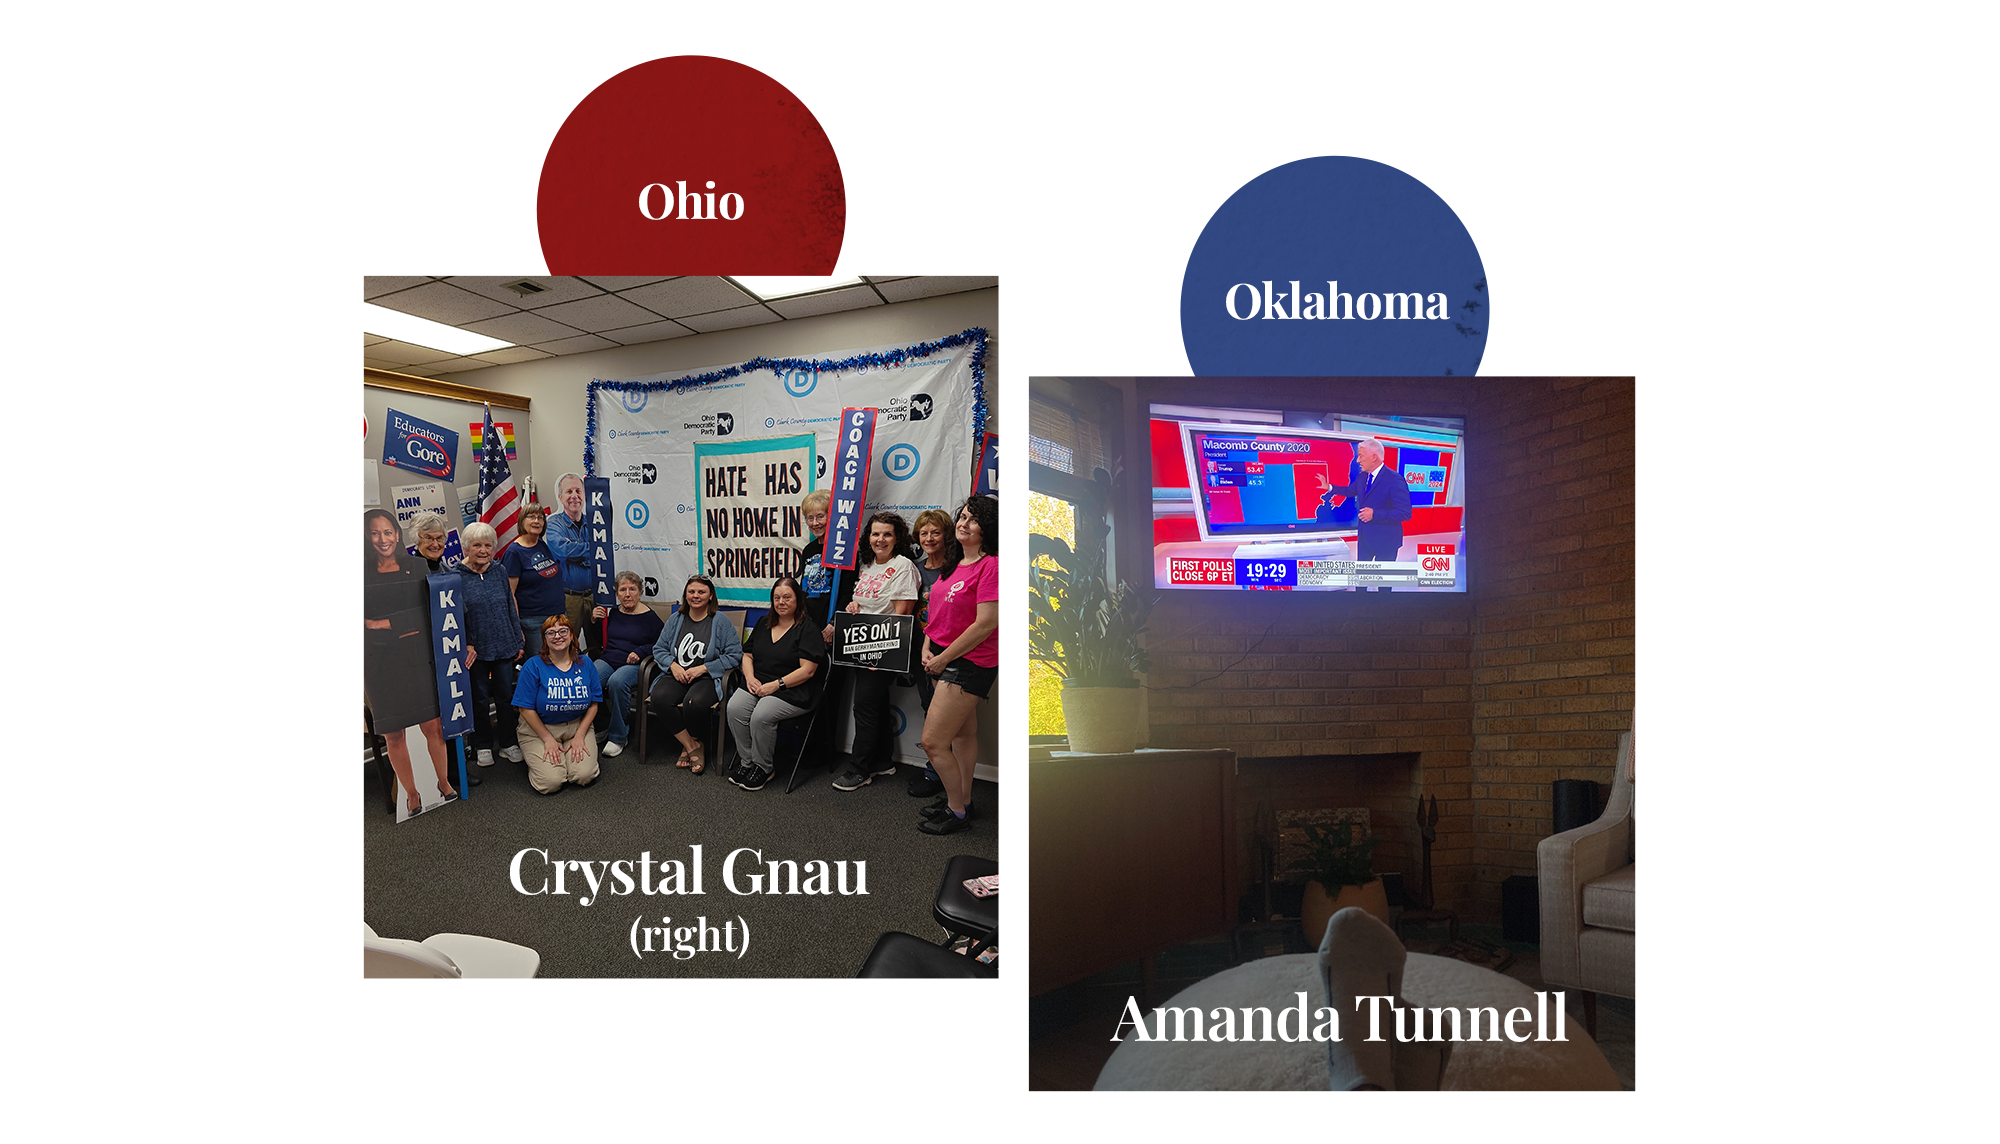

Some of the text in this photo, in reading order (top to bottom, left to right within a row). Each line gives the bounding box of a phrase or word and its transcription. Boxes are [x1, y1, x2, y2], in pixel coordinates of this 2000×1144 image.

[878, 405, 907, 414] mocratic
[776, 416, 790, 425] Clark
[790, 417, 807, 427] County
[888, 413, 907, 421] Party
[394, 416, 445, 444] Educators
[684, 422, 715, 430] Democratic
[397, 431, 408, 440] for
[406, 440, 445, 466] Gore
[842, 412, 865, 491] COACH
[1203, 440, 1311, 453] Macomb County 2020
[628, 477, 641, 485] Party
[705, 461, 802, 498] HATE HAS
[1405, 472, 1425, 484] CNN
[396, 496, 421, 509] ANN
[865, 502, 880, 510] Clark
[880, 503, 899, 513] County
[706, 506, 802, 538] NO HOME IN
[833, 499, 856, 561] WALZ
[591, 492, 610, 595] KAMALA
[707, 547, 803, 579] SPRINGFIELD
[1172, 561, 1233, 571] FIRST POLLS
[1422, 557, 1450, 571] CNN
[1172, 571, 1233, 582] CLOSE 6P ET
[1246, 563, 1287, 578] 19:29
[843, 621, 900, 644] YES ON 1
[439, 589, 467, 722] KAMALA
[868, 651, 882, 660] OHIO
[547, 677, 574, 687] ADAM
[547, 685, 589, 699] MILLER
[545, 704, 558, 712] FOR
